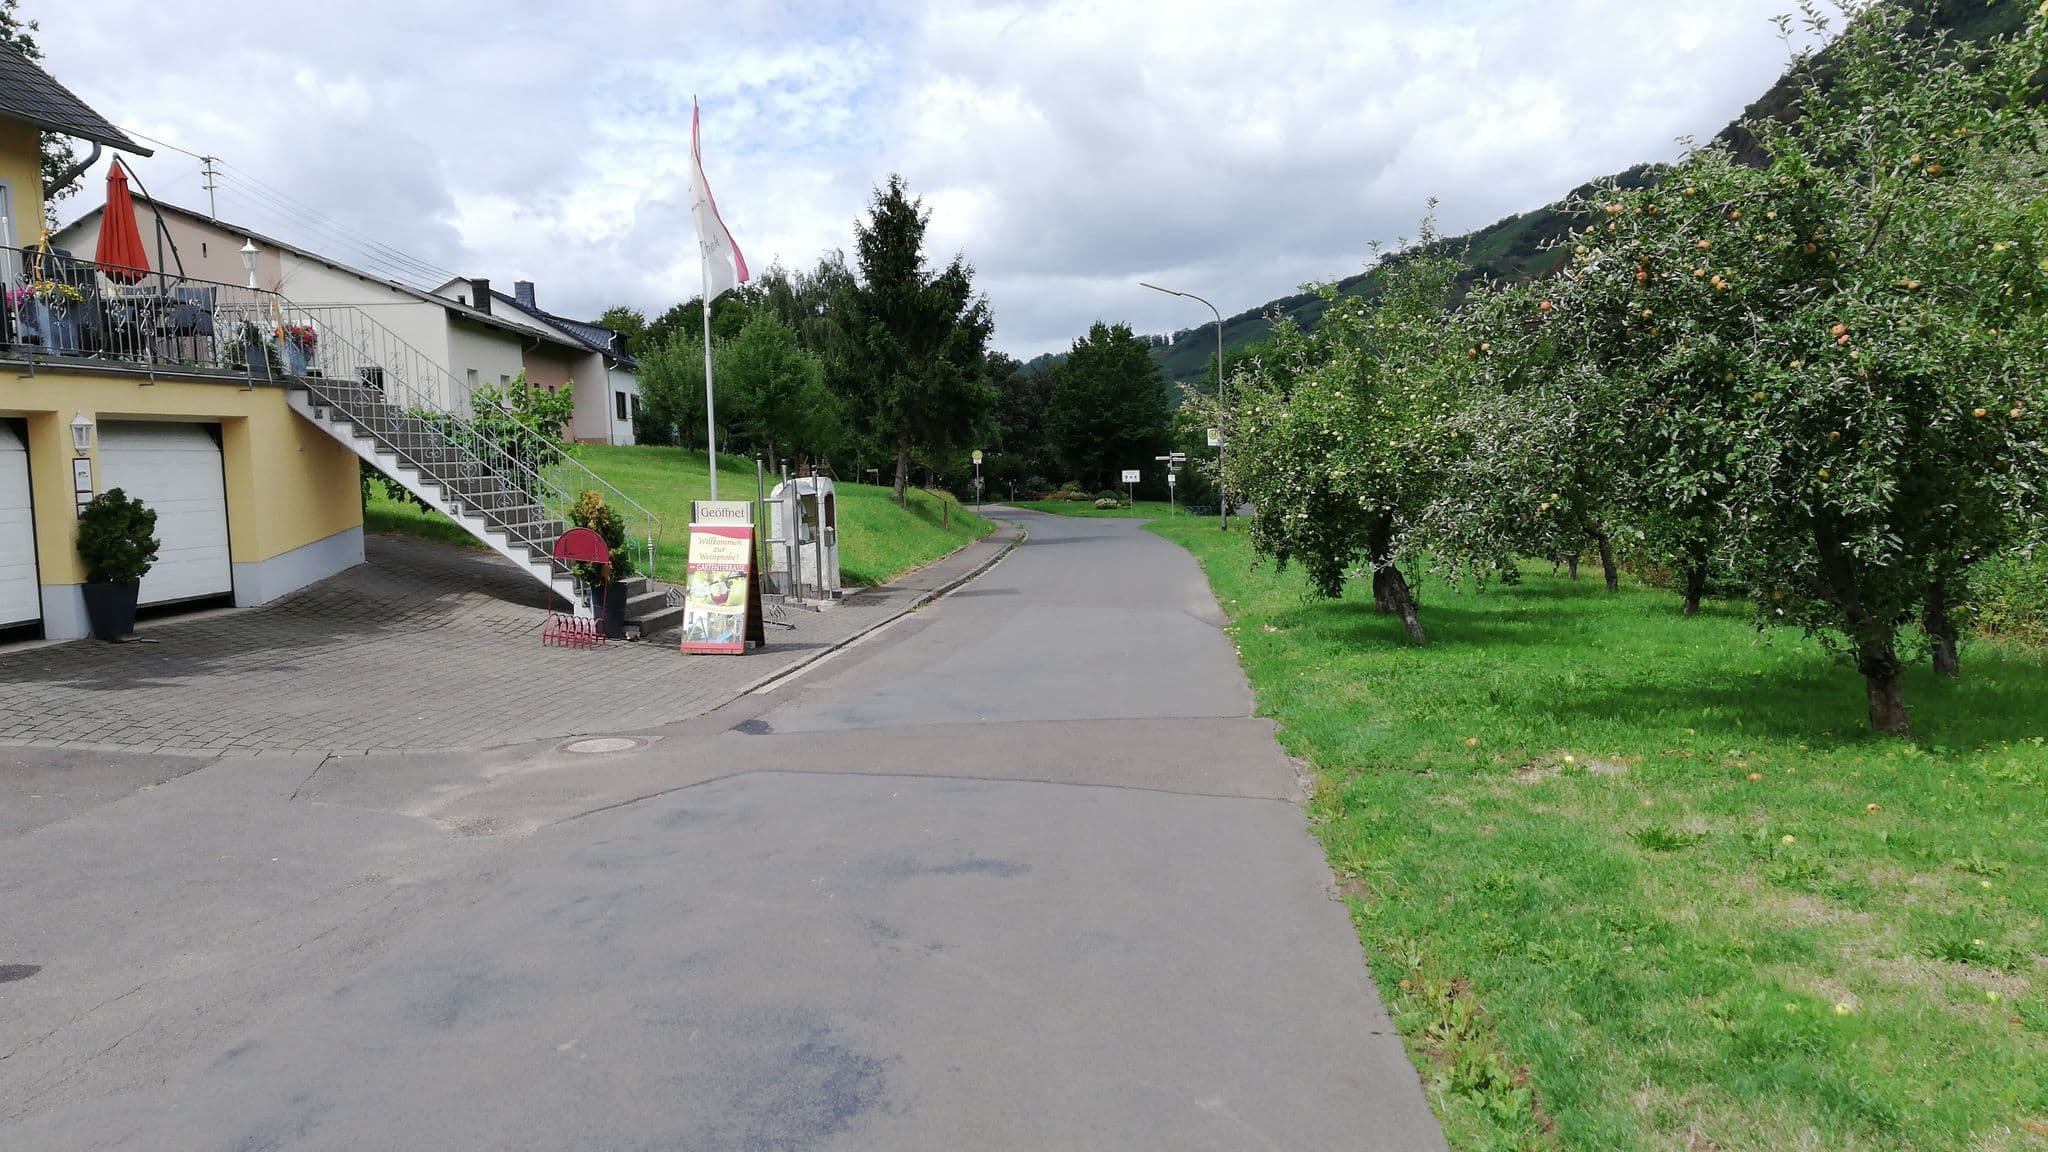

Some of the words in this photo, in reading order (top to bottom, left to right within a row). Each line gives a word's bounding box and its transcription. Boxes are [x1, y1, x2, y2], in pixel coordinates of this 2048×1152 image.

[701, 507, 745, 518] Geöffnet
[699, 536, 742, 546] Willkommen
[699, 552, 739, 562] Weinprobe!
